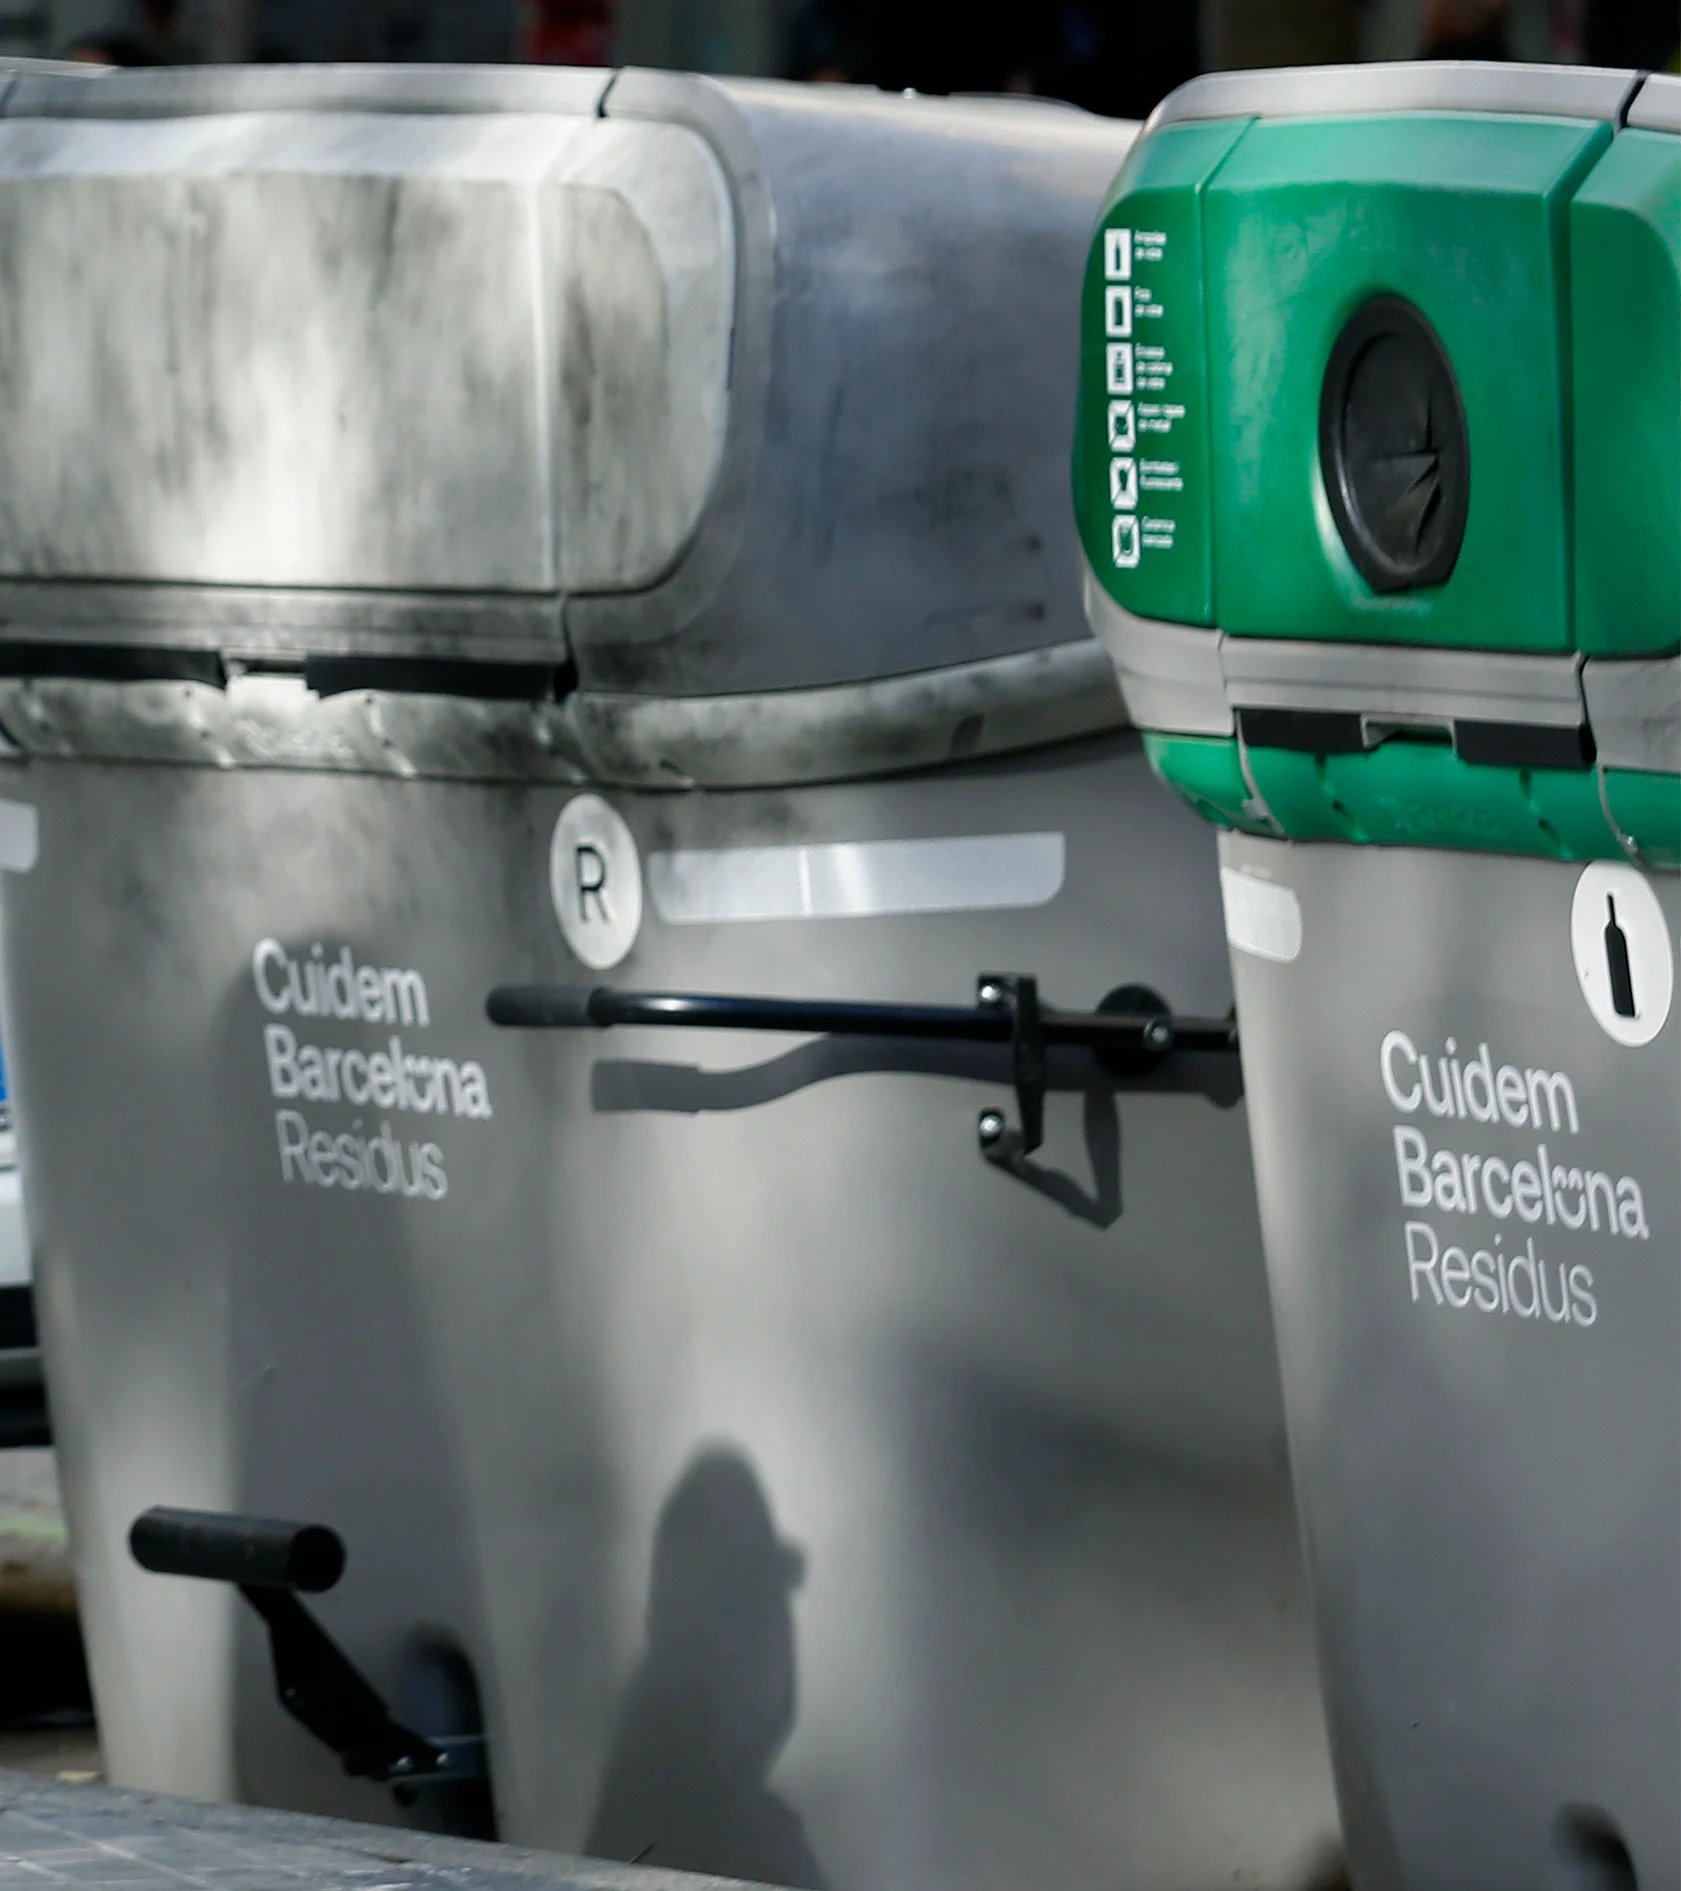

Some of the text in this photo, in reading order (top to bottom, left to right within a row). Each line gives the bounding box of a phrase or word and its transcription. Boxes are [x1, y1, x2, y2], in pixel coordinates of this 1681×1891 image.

[575, 843, 609, 923] R
[252, 937, 429, 1027] Cuidem
[1380, 1029, 1579, 1134] Cuidem
[275, 1108, 448, 1200] Residus
[1404, 1219, 1598, 1327] Residus
